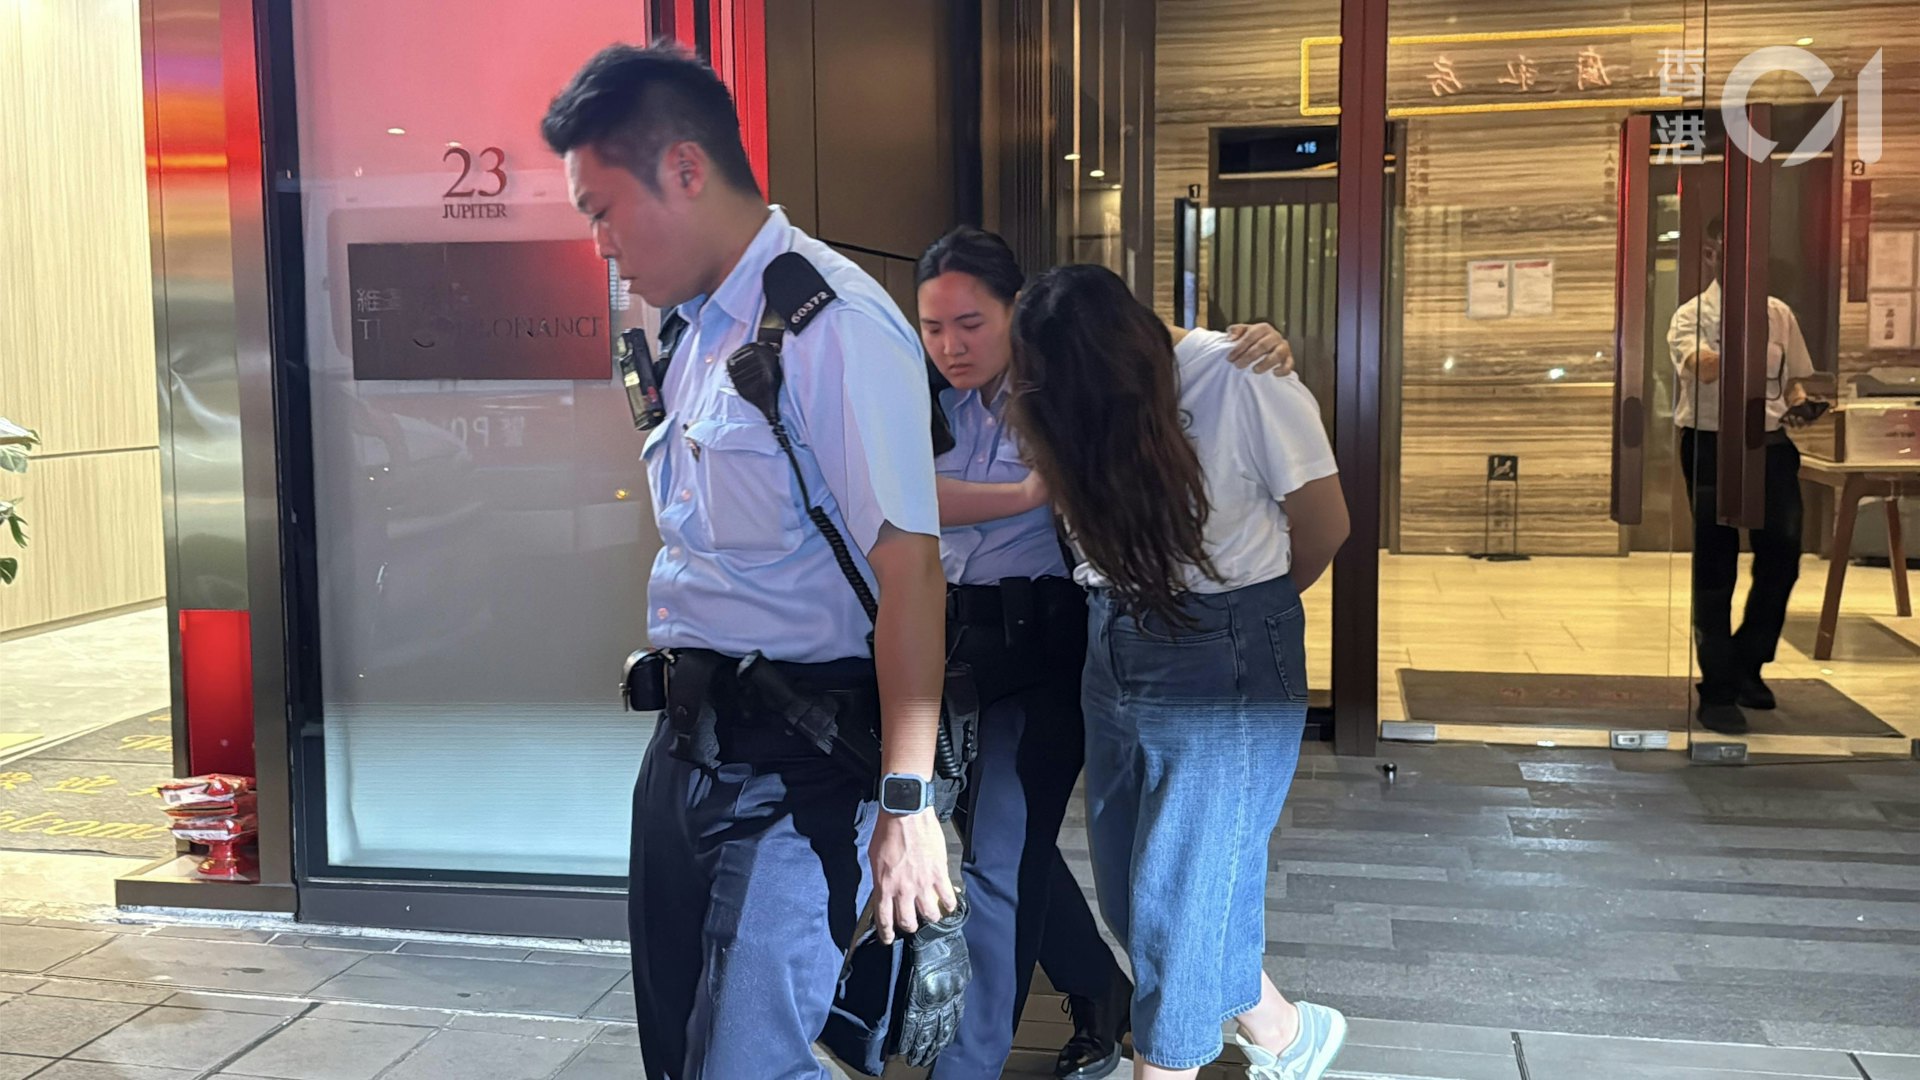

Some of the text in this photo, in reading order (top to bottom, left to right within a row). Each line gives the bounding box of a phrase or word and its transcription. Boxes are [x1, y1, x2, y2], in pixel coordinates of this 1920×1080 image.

[442, 147, 507, 198] 23
[1852, 162, 1863, 175] 2
[442, 203, 508, 219] JUPITER
